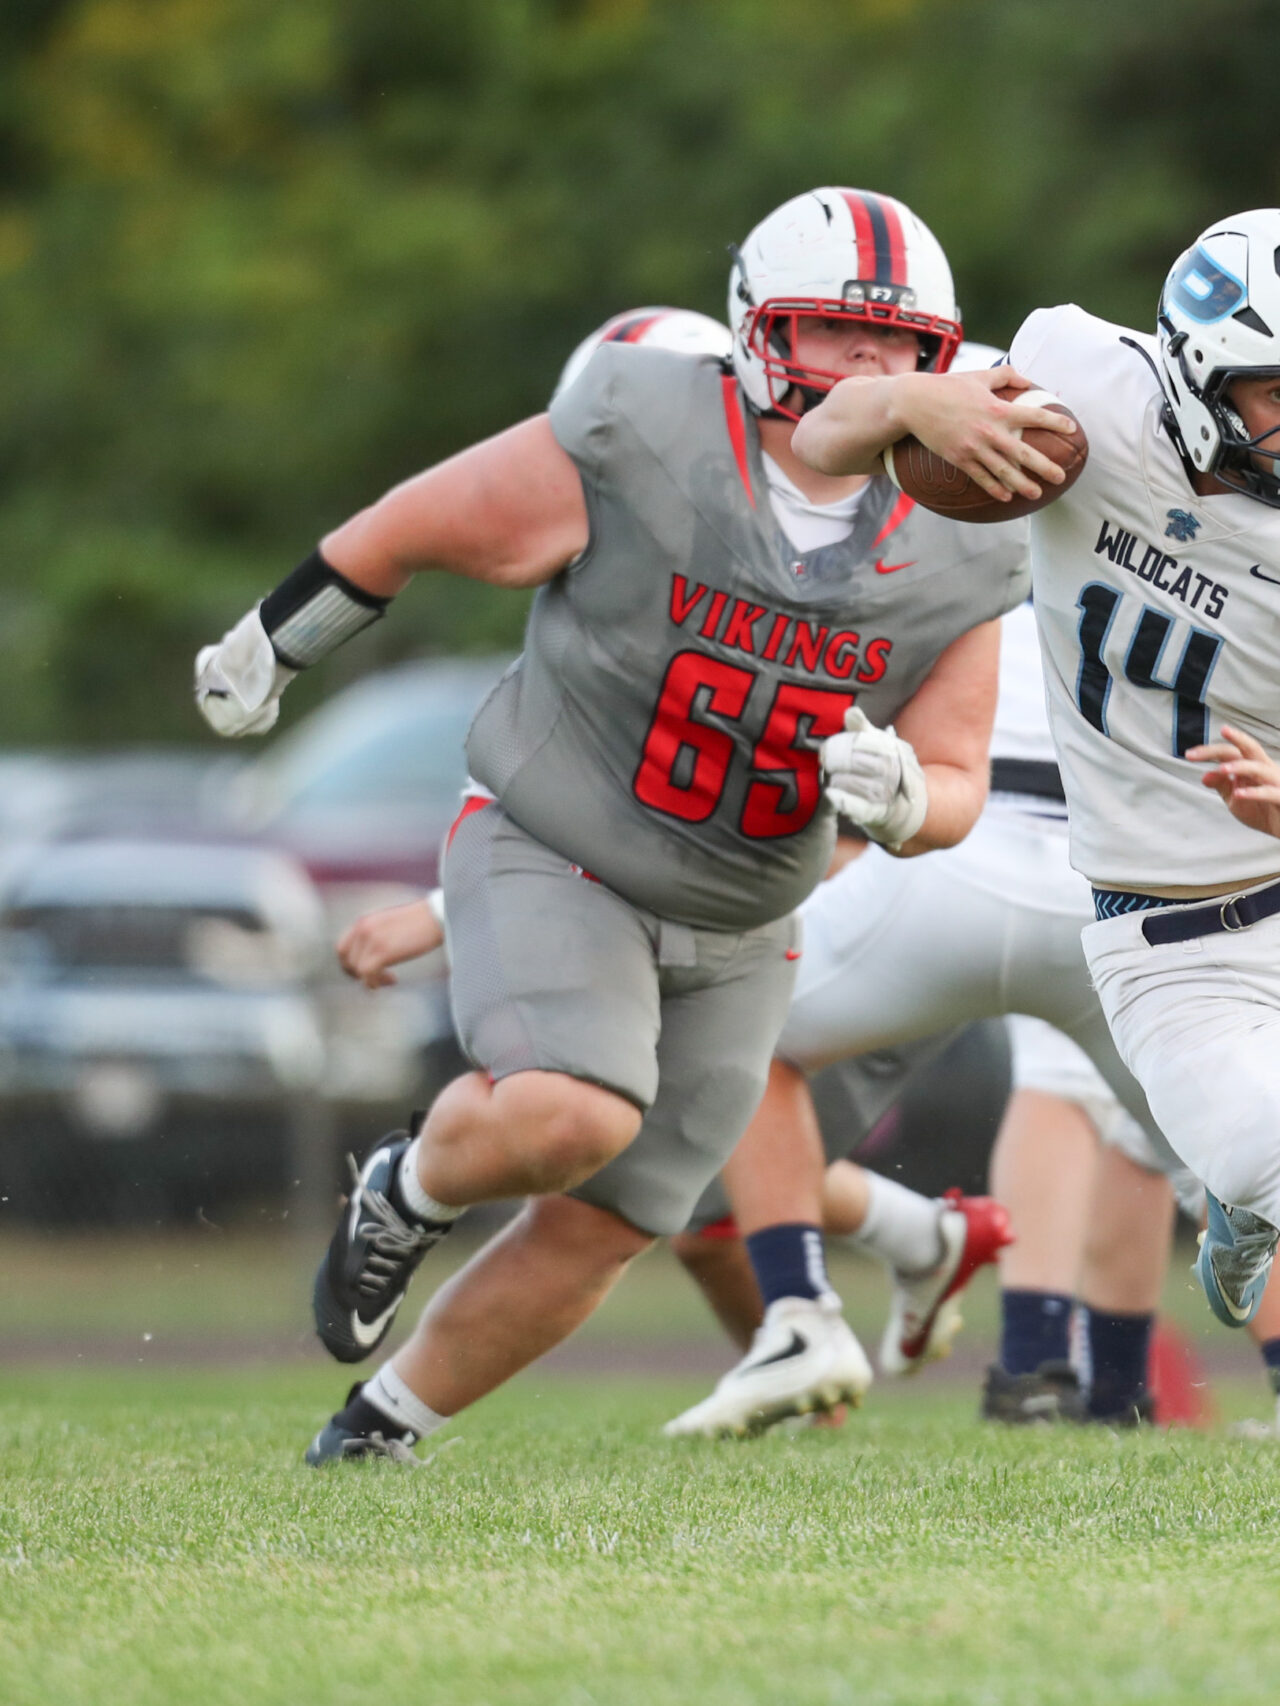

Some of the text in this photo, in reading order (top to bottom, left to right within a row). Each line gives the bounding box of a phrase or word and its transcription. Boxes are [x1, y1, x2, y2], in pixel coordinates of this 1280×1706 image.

[870, 285, 893, 302] F7
[1094, 519, 1229, 620] WILDCATS
[669, 572, 893, 684] VIKINGS
[1075, 579, 1225, 759] 14
[631, 648, 856, 840] 65
